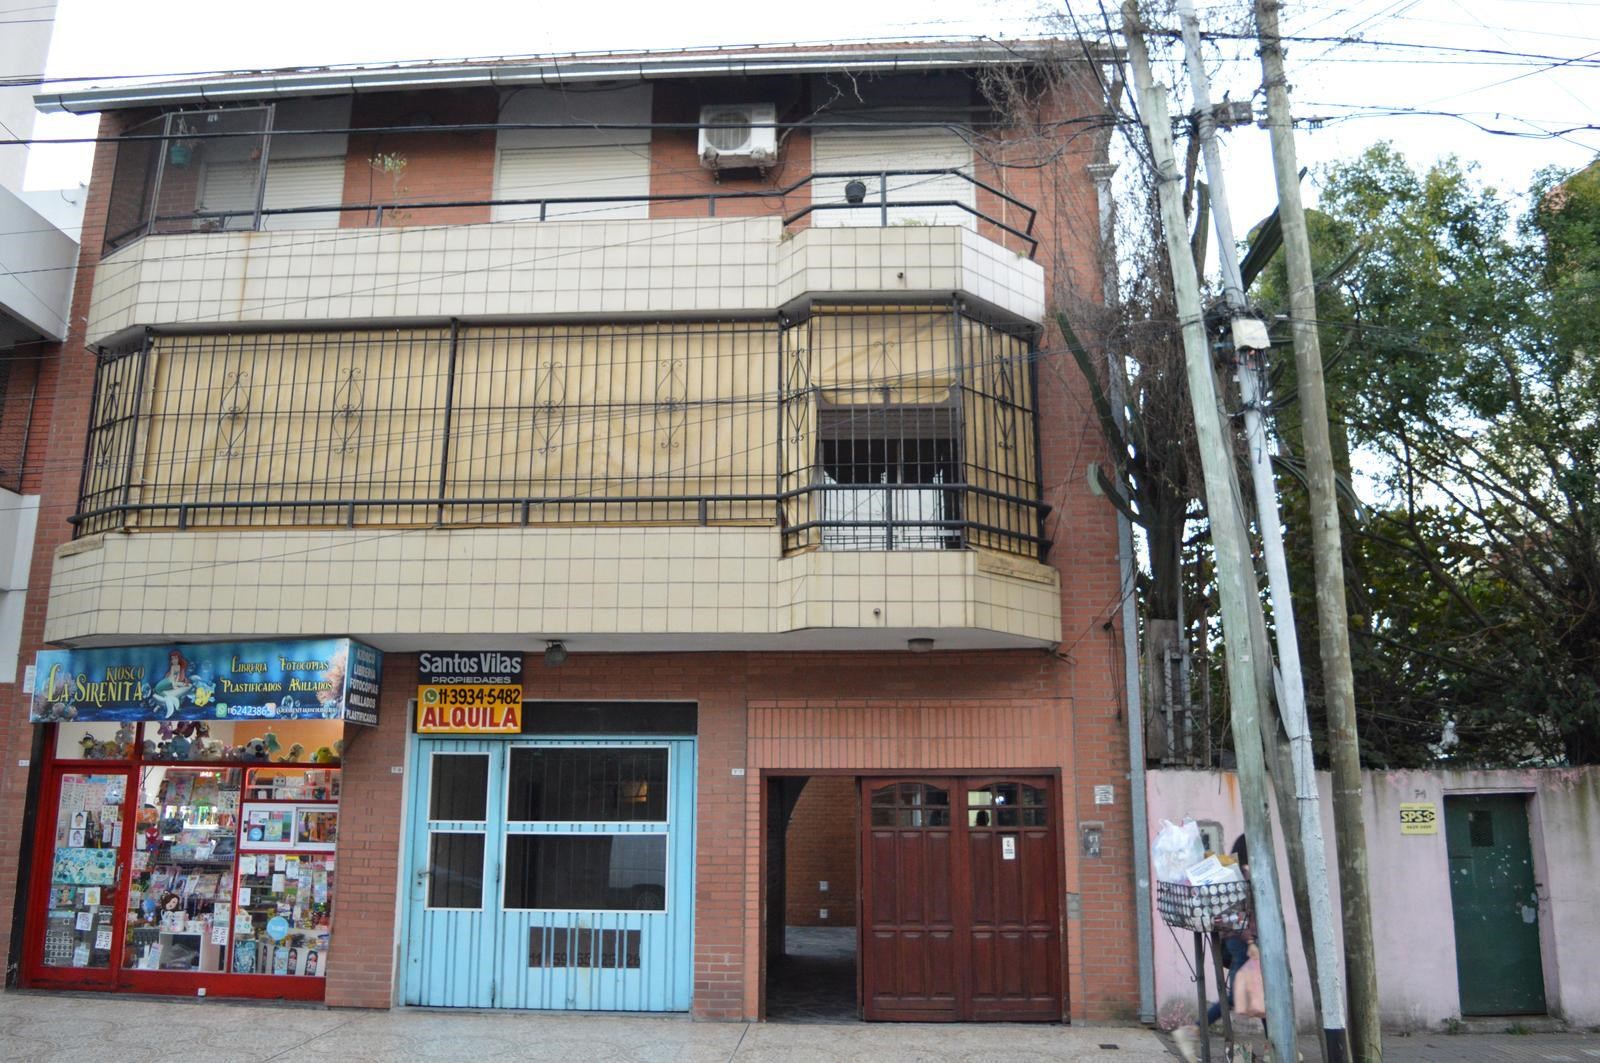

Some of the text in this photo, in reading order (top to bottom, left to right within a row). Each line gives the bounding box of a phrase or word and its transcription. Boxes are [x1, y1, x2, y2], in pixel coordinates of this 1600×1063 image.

[231, 655, 329, 673] LIBRERIA FOTOCOPIAS
[420, 652, 521, 673] Santos Vilas
[106, 665, 145, 684] KIOSCO
[431, 676, 512, 684] PROPIEDADES
[75, 673, 142, 708] SIRENITA
[220, 677, 333, 693] PLASTIFICADOS ANILLADOS
[350, 678, 379, 695] FOTOCOPIAS
[349, 692, 376, 709] ANILLADOS
[421, 706, 519, 728] ALQUILA
[1401, 810, 1424, 822] SPS
